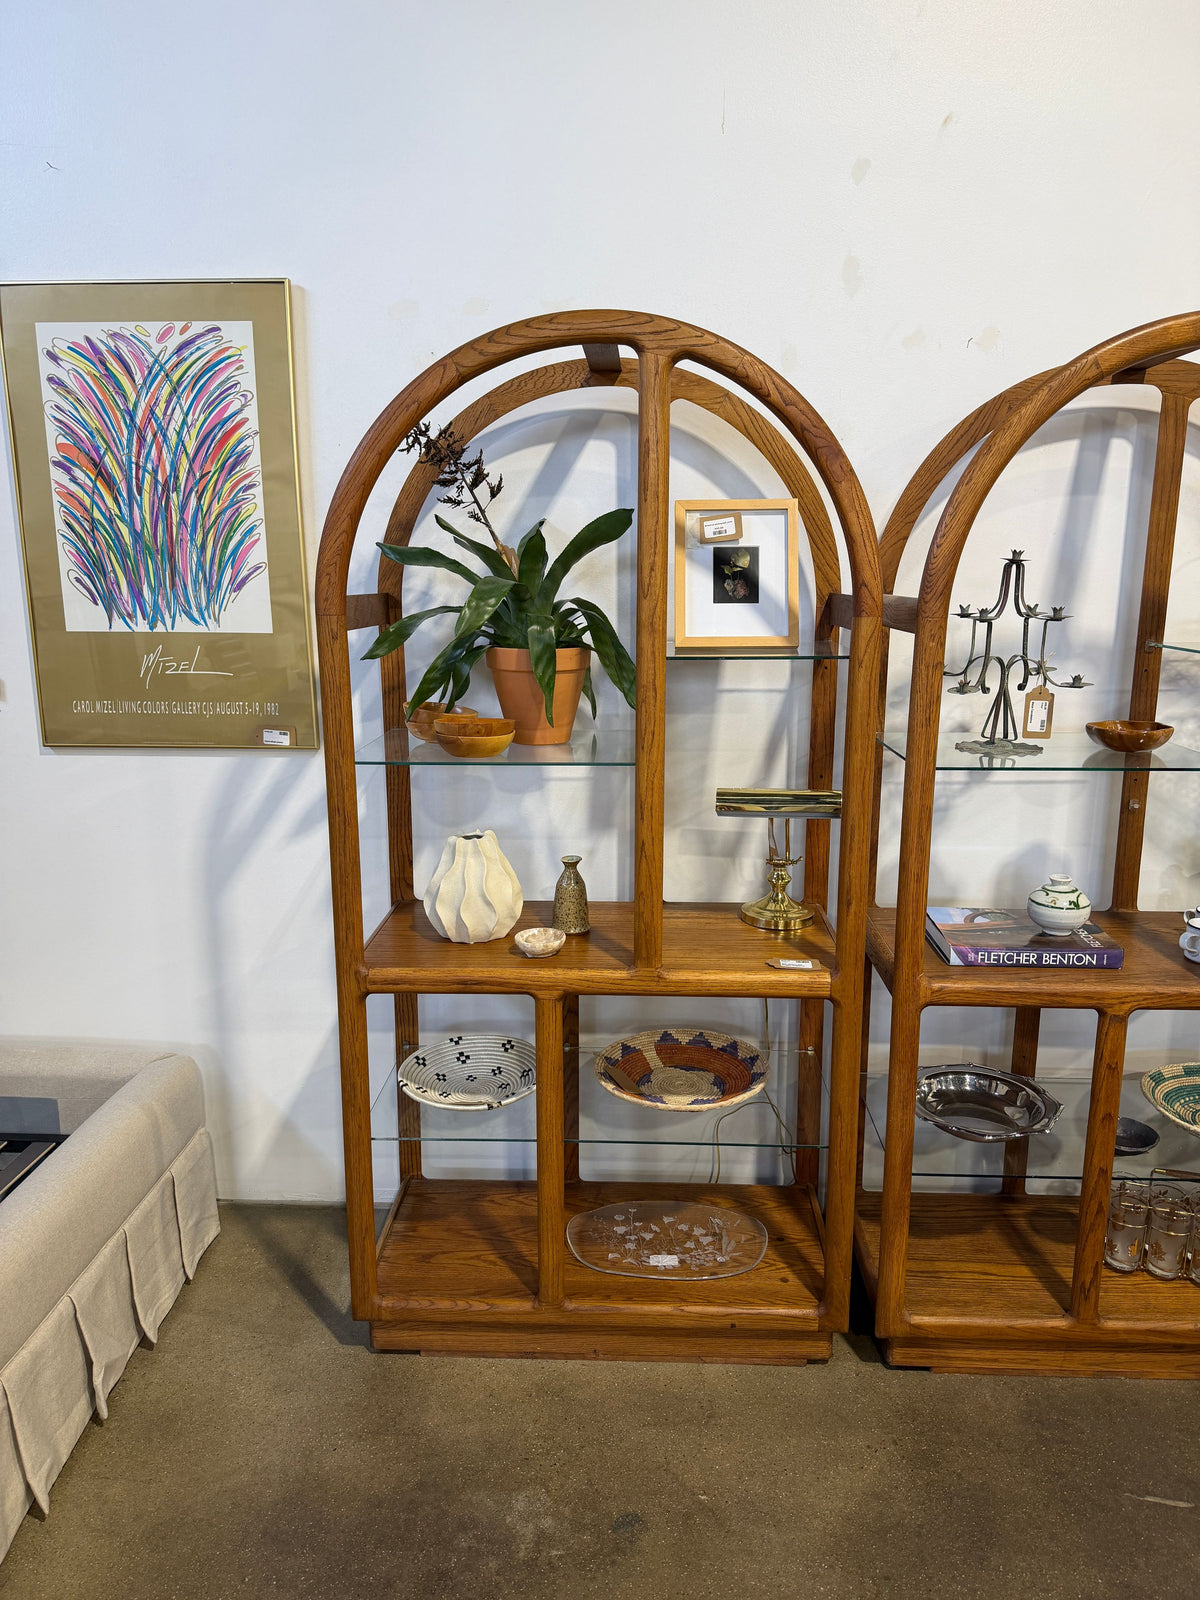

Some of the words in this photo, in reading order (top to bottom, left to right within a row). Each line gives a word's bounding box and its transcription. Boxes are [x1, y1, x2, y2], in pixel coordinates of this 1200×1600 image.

[73, 700, 94, 713] CAROL
[96, 700, 116, 713] MIZEL
[119, 701, 141, 713] LIVING
[143, 701, 169, 714] COLORS
[171, 701, 200, 714] GALLERY
[216, 702, 243, 714] AUGUST
[245, 702, 262, 717] 5-19,
[264, 702, 279, 715] 1982
[978, 951, 1037, 965] FLETCHER
[1042, 952, 1097, 966] BENTON
